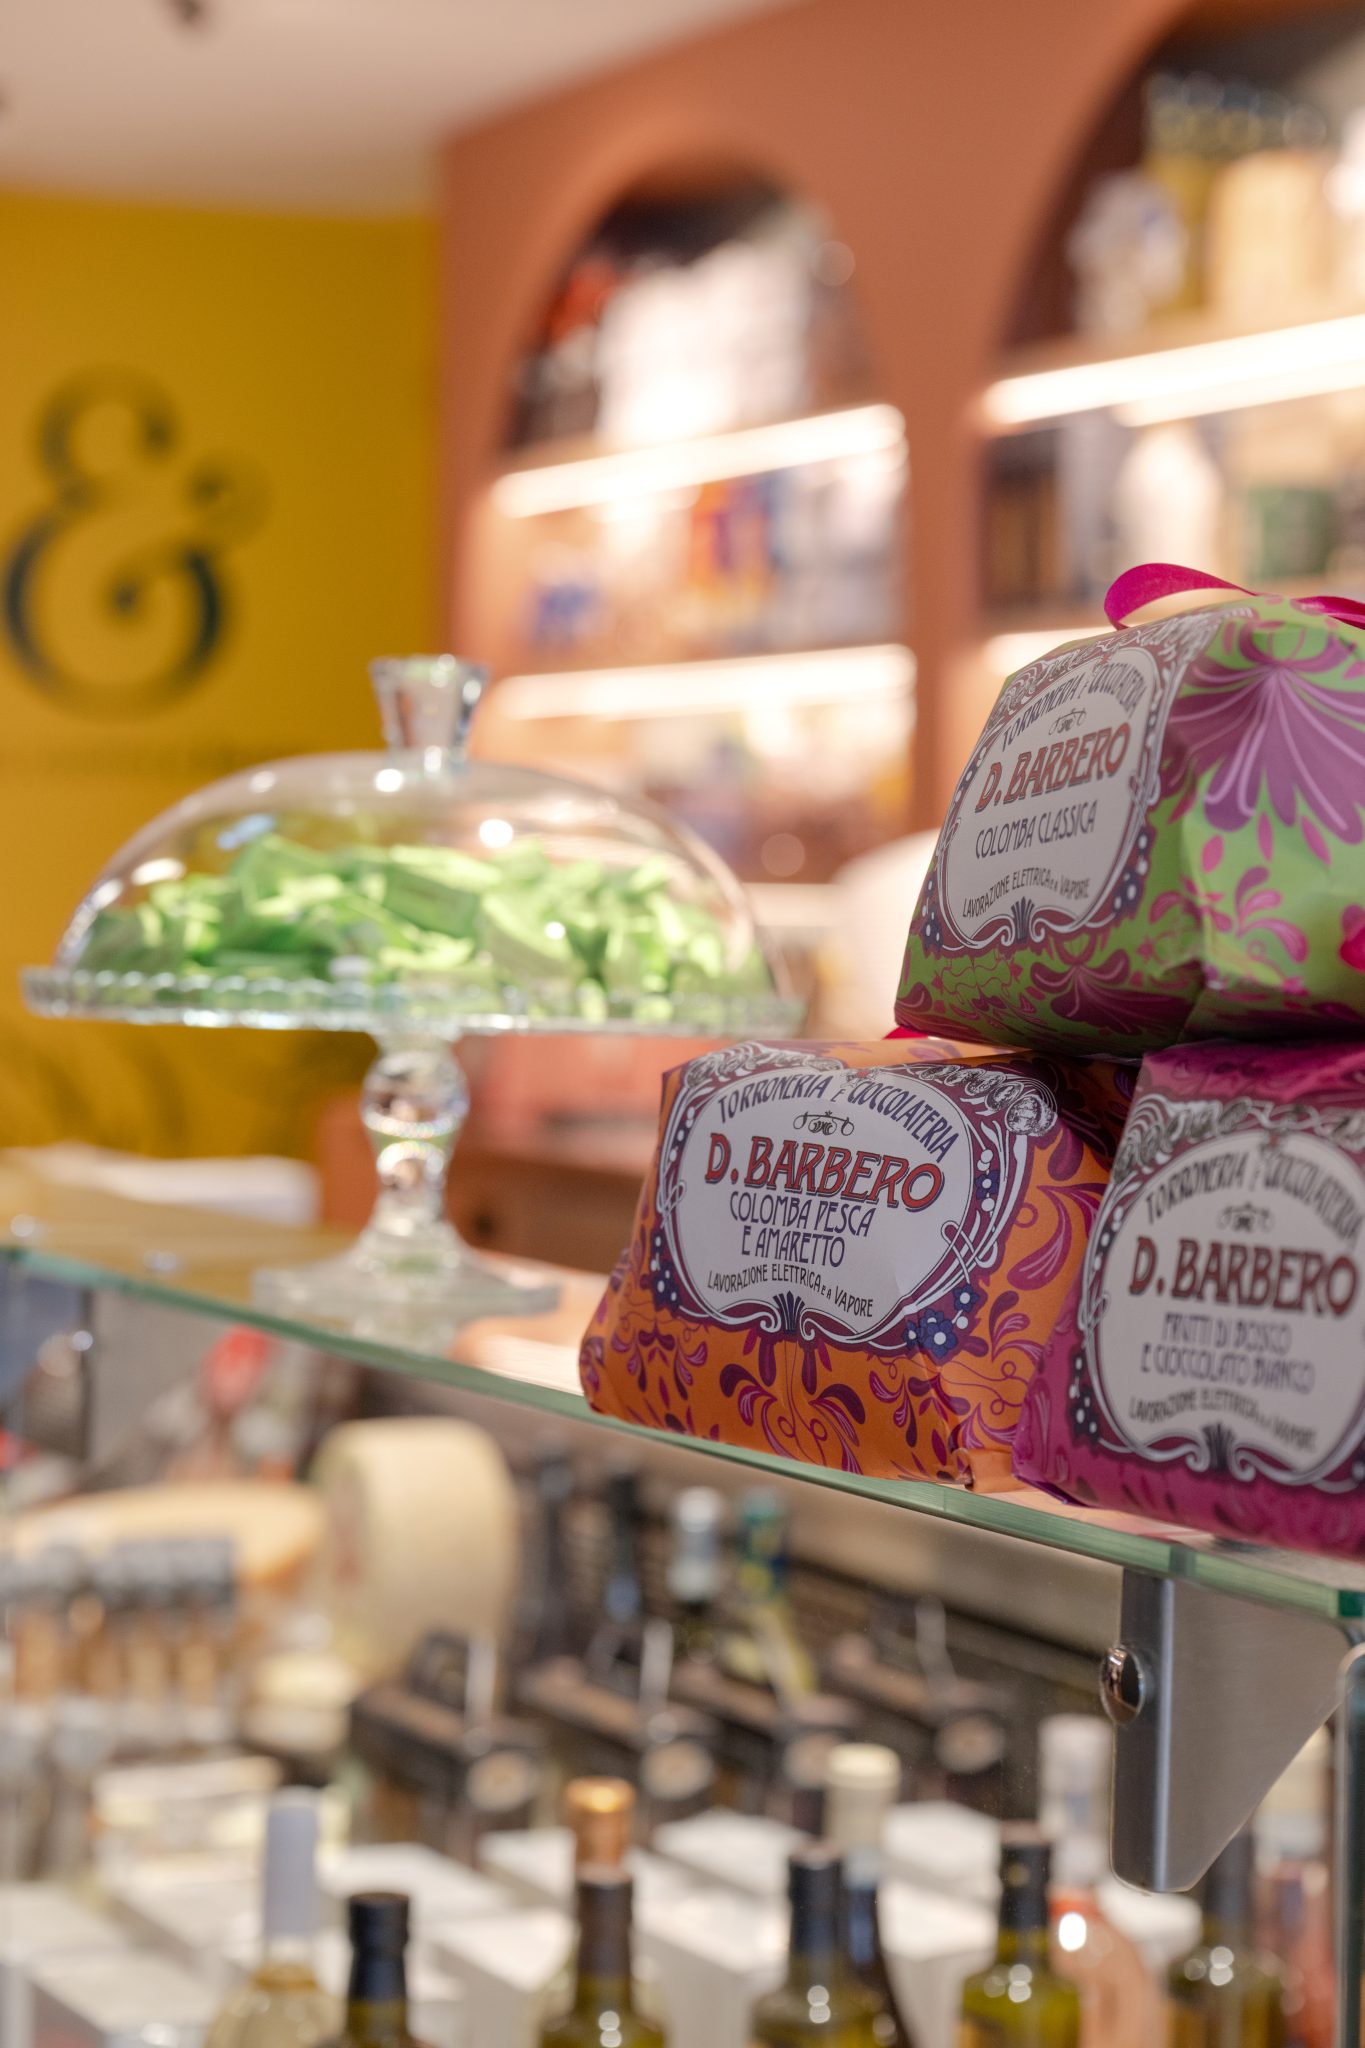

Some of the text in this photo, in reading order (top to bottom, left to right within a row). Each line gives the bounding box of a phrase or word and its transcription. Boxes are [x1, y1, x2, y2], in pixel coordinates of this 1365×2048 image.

[2, 362, 270, 724] &
[1002, 672, 1086, 752] TORRONERIA
[975, 722, 1131, 813] D. BARBERO
[975, 800, 1098, 859] COLOMBA CLASSICA
[962, 874, 1010, 918] LAVORAZIONE
[1012, 867, 1051, 890] ELETTRICA
[718, 1074, 959, 1163] TORRONERIA E CIOCCOLATERIA
[704, 1132, 945, 1212] D. BARBERO
[730, 1191, 877, 1237] COLOMBA PESCA
[741, 1225, 846, 1268] E AMARETTO
[707, 1264, 768, 1293] LAVORAZIONE
[771, 1263, 822, 1293] ELETTRICA
[834, 1285, 873, 1317] VAPORE
[1129, 1235, 1358, 1316] D. BARBERO
[1251, 1356, 1316, 1395] BIANCO
